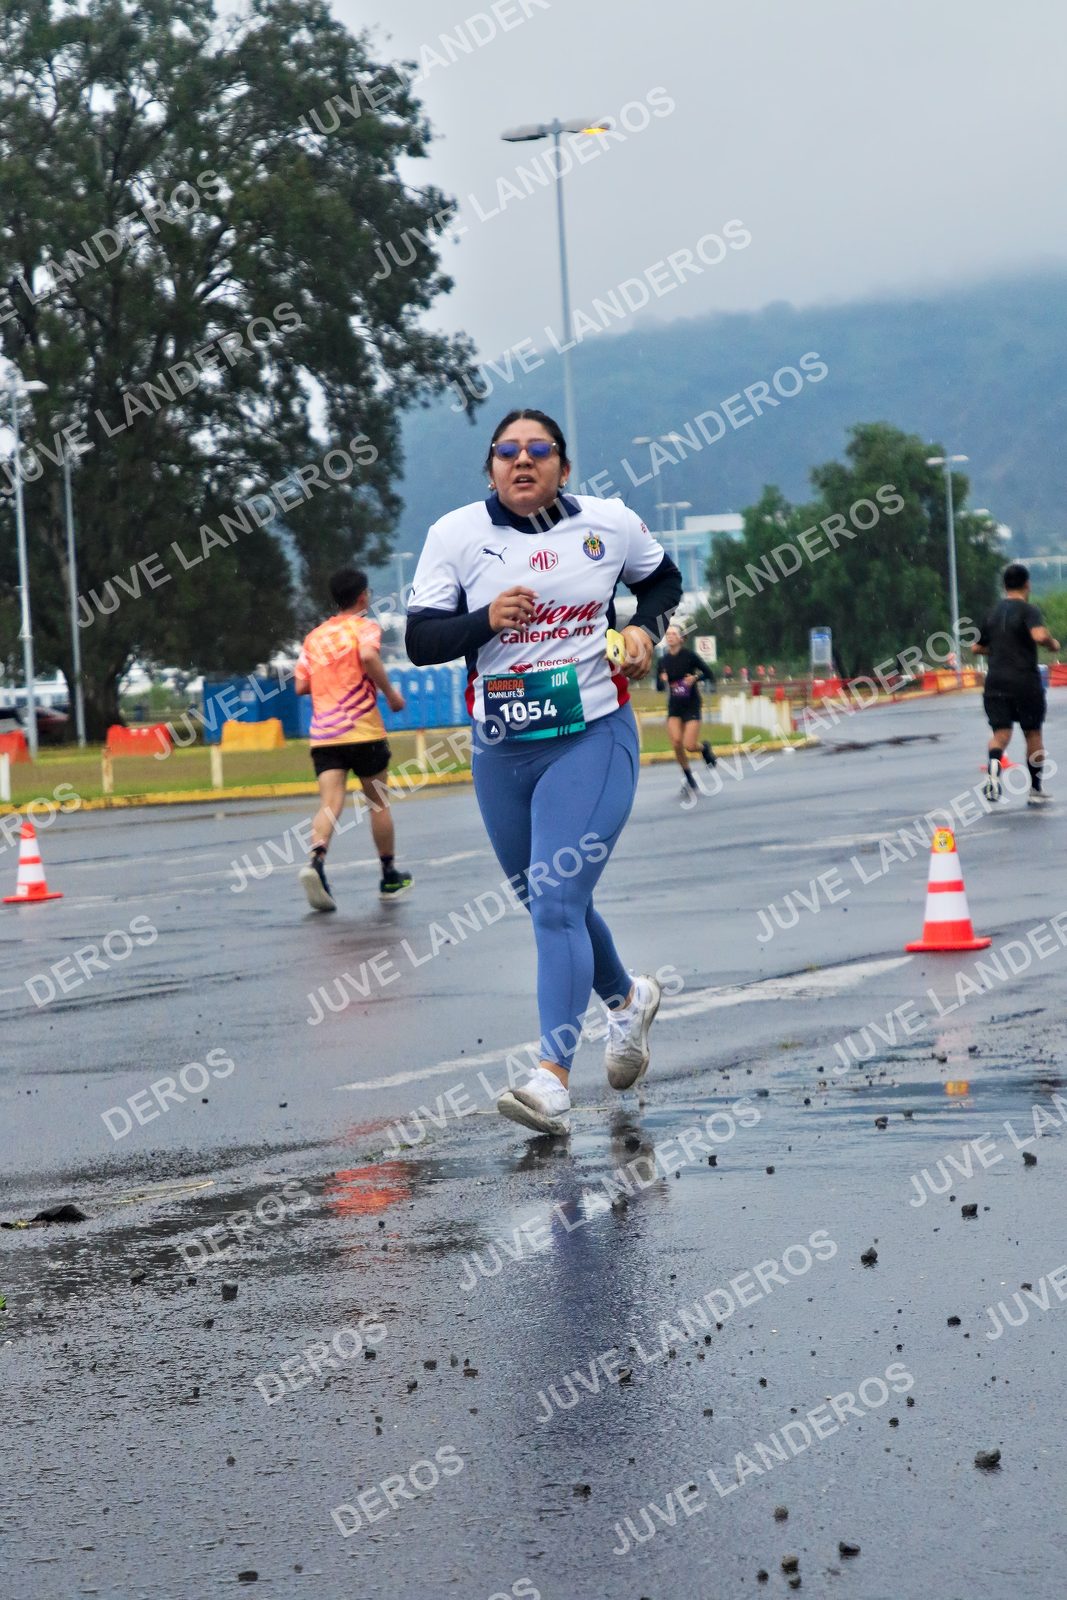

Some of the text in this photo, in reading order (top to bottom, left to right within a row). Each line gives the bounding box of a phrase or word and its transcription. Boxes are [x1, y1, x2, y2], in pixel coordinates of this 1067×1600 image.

[530, 550, 558, 571] MG
[500, 624, 595, 644] caliente.mx
[537, 656, 580, 667] mercado
[487, 679, 524, 691] CARRERA
[551, 671, 569, 688] 10K
[499, 698, 558, 723] 1054
